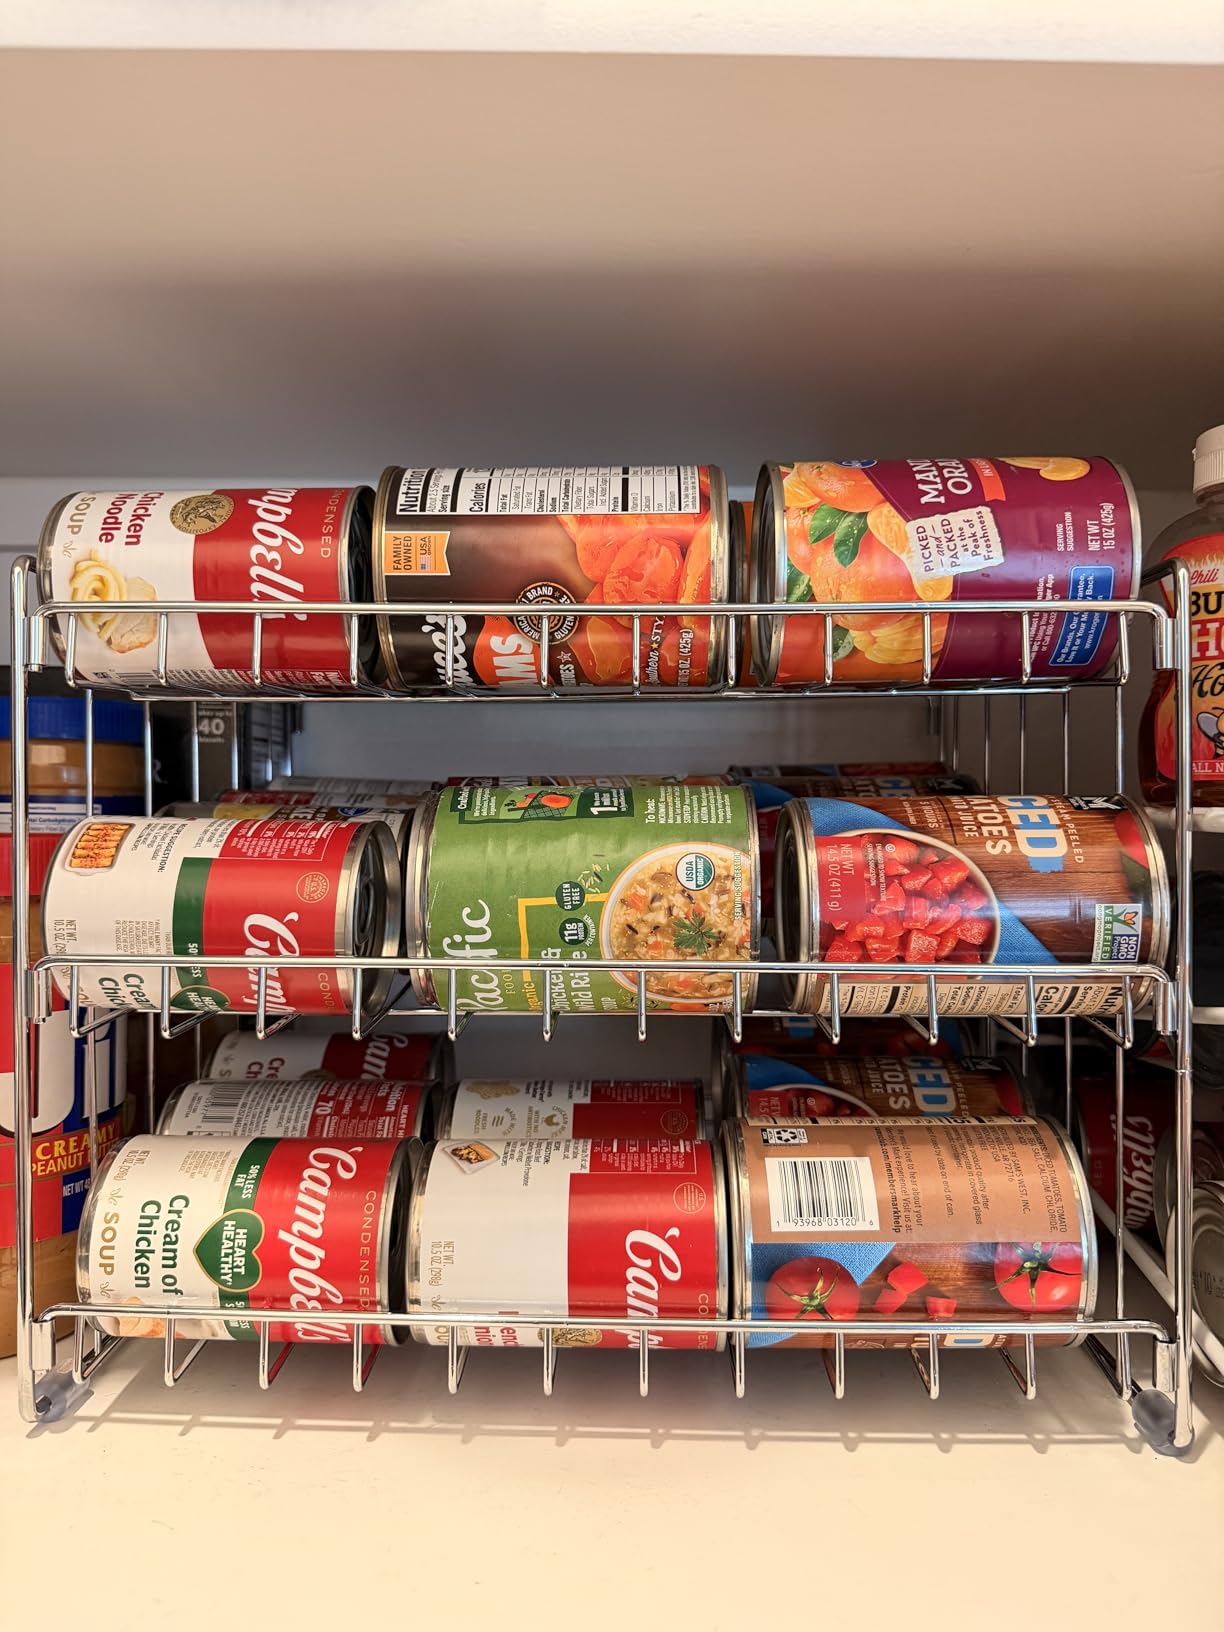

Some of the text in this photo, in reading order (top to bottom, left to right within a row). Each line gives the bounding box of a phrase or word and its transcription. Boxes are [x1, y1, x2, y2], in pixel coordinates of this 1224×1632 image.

[399, 469, 426, 512] Nutrition
[439, 485, 450, 513] Serving size
[468, 482, 487, 512] Calories
[511, 491, 521, 510] Saturated
[536, 489, 545, 513] Cholesterol
[573, 495, 582, 510] Dietary
[586, 498, 594, 510] Total
[611, 496, 619, 513] Protein
[642, 496, 651, 513] Calcium
[667, 491, 676, 513] Potassium
[67, 496, 96, 536] SOUP
[98, 493, 130, 544] Noodle
[499, 501, 508, 512] Total
[547, 497, 557, 513] Sodium
[561, 501, 570, 513] Total
[630, 497, 639, 513] Vitamin
[655, 503, 663, 513] Iron
[125, 492, 164, 547] Chicken
[1064, 511, 1074, 552] SUGGESTION
[1099, 502, 1116, 550] 15 OZ (425g)
[419, 535, 428, 556] USA
[915, 525, 934, 573] PICKED
[929, 535, 945, 557] and
[940, 518, 960, 568] PACKED
[957, 526, 969, 553] at the
[963, 518, 982, 557] Peak of
[975, 510, 994, 561] Freshness
[1056, 523, 1065, 552] SERVING
[1086, 519, 1101, 551] NET WT
[392, 535, 402, 571] FAMILY
[403, 535, 413, 571] OWNED
[526, 586, 553, 600] BRAND
[1045, 574, 1055, 588] App
[680, 628, 694, 657] (425g)
[1056, 617, 1080, 664] Our Brands. Our
[1065, 622, 1087, 664] Love Your
[199, 718, 225, 735] 40
[644, 798, 656, 824] To heat:
[926, 805, 939, 828] HOURS
[963, 811, 979, 838] JUICE
[157, 836, 178, 873] SUGGESTION:
[1066, 823, 1083, 864] PEELED
[686, 860, 694, 882] USDA
[696, 857, 705, 885] ORGANIC
[827, 844, 842, 898] 14.5 OZ (411
[840, 843, 856, 876] NET WT
[866, 843, 877, 887] SERVING SUGGESTION
[733, 851, 743, 921] SERVING SUGGESTION
[878, 869, 886, 883] SHOW
[563, 883, 572, 910] GLUTEN
[571, 887, 581, 905] FREE
[879, 882, 887, 902] TEXTURE
[53, 919, 66, 932] 10.5
[65, 919, 78, 944] NET WT.
[563, 922, 578, 942] 11g
[1093, 904, 1103, 962] nongmoproject.org
[1101, 908, 1113, 960] VERIFIED
[1111, 936, 1121, 959] Project
[1118, 936, 1129, 960] GMO
[1126, 936, 1138, 959] NON
[898, 986, 912, 1006] Protein
[961, 986, 973, 1006] Sodium
[315, 1100, 334, 1115] 70
[398, 1104, 409, 1129] HEART
[233, 1174, 247, 1188] FAT
[241, 1164, 260, 1199] 50% LESS
[895, 1160, 908, 1196] experience!
[902, 1197, 912, 1213] Visit
[969, 1149, 990, 1211] product quality after
[1002, 1162, 1015, 1183] 72716
[62, 1182, 75, 1198] NET
[902, 1150, 924, 1227] love hear about your
[935, 1157, 955, 1217] date end can.
[1011, 1159, 1032, 1215] SAM'S WEST, INC.
[1031, 1147, 1059, 1233] SALT, CALCIUM CHLORIDE,
[1041, 1152, 1055, 1168] DICED
[1048, 1168, 1062, 1204] TOMATOES,
[1056, 1204, 1068, 1233] TOMATO
[968, 1178, 983, 1225] covered glass
[792, 1216, 857, 1228] 93968 03120
[98, 1211, 120, 1276] SOUP
[134, 1199, 162, 1289] Chicken
[161, 1194, 190, 1296] Cream of
[234, 1228, 248, 1275] HEART
[358, 1190, 377, 1308] CONDENSED
[443, 1240, 455, 1267] NET WT.
[428, 1240, 443, 1287] 10.5 OZ. (298g)
